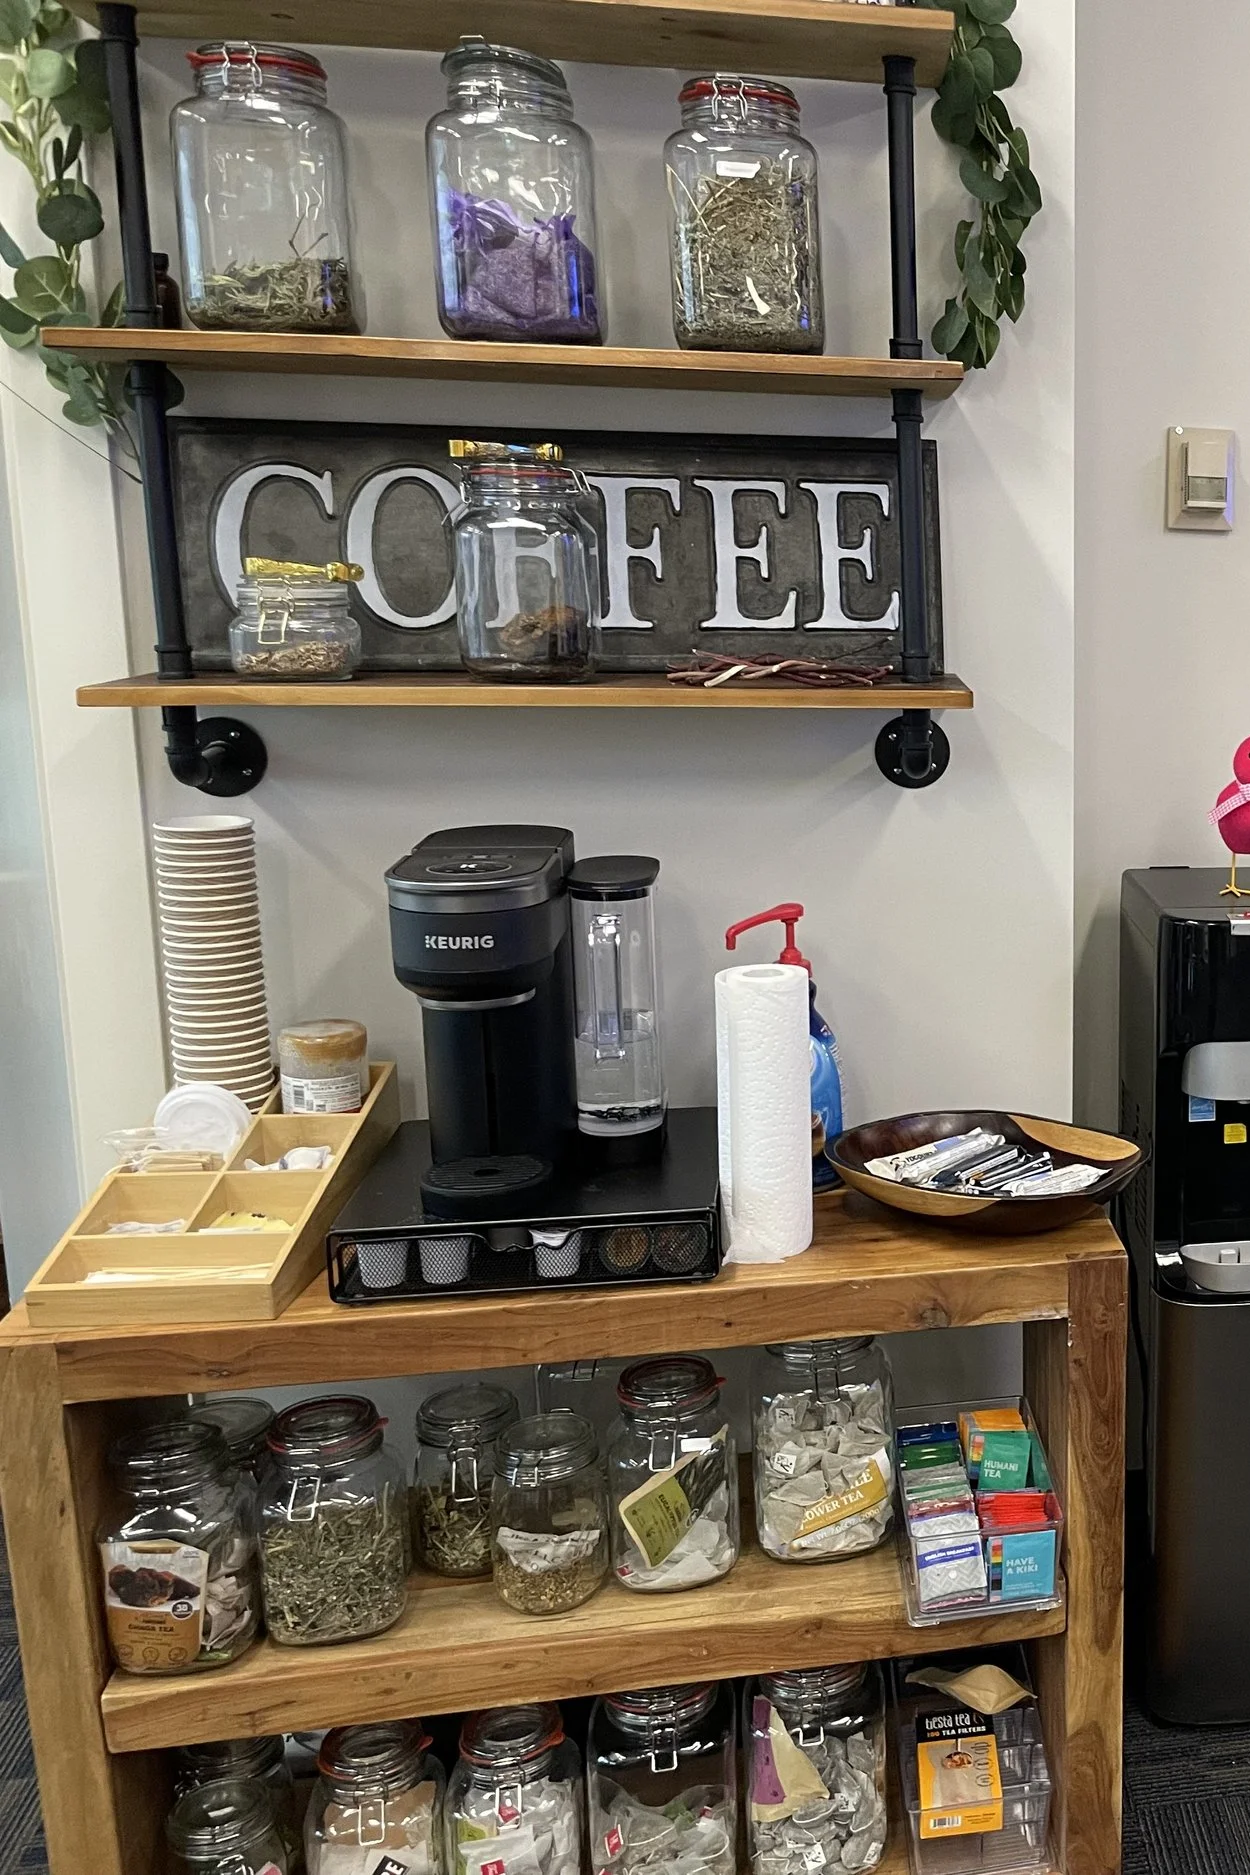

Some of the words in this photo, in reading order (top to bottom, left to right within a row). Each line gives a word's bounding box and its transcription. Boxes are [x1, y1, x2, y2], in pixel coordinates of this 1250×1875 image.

[213, 463, 900, 632] COFFEE
[424, 935, 495, 950] KEURIG
[983, 1468, 1001, 1479] TEA
[839, 1490, 864, 1507] TEA
[1005, 1556, 1036, 1567] HAVE
[1006, 1566, 1015, 1575] A
[1015, 1564, 1038, 1575] KIKI
[925, 1714, 953, 1731] tiesta
[954, 1712, 971, 1727] tea
[957, 1725, 987, 1735] FILTERS
